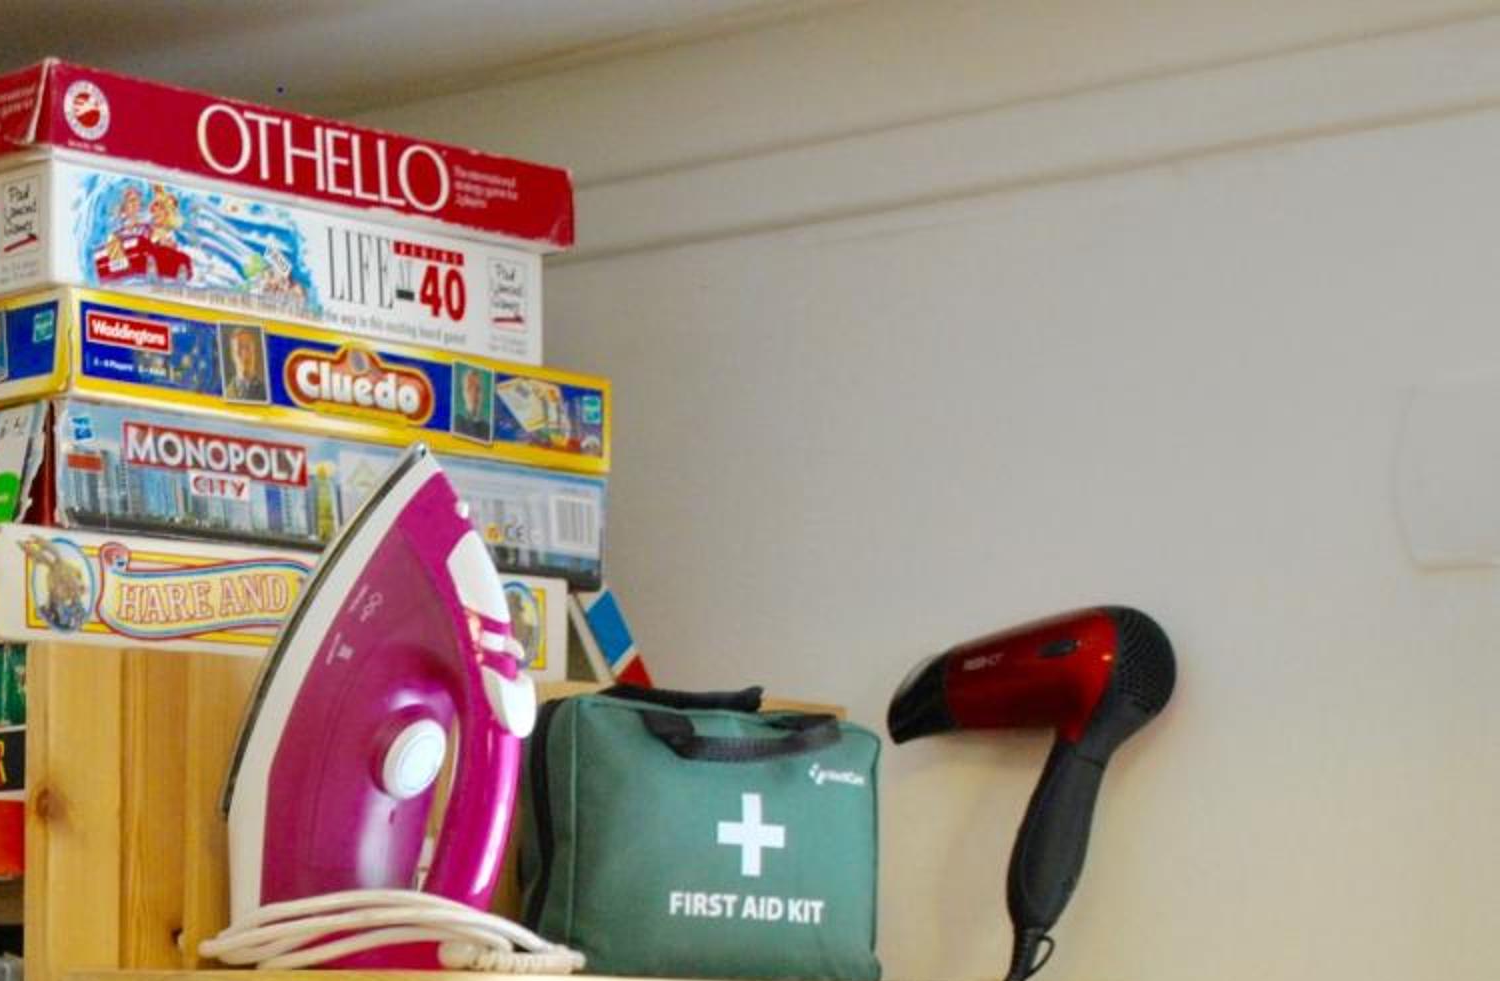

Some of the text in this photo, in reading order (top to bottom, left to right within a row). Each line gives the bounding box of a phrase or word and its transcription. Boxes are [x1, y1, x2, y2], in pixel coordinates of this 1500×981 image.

[199, 104, 450, 213] OTHELLO
[328, 227, 394, 309] LIFE
[420, 265, 466, 322] 40
[296, 359, 420, 414] Cluedo
[126, 424, 305, 482] MONOPOLY
[192, 475, 246, 497] CITY
[118, 574, 288, 623] HARE AND
[669, 891, 824, 924] FIRST AID KIT
